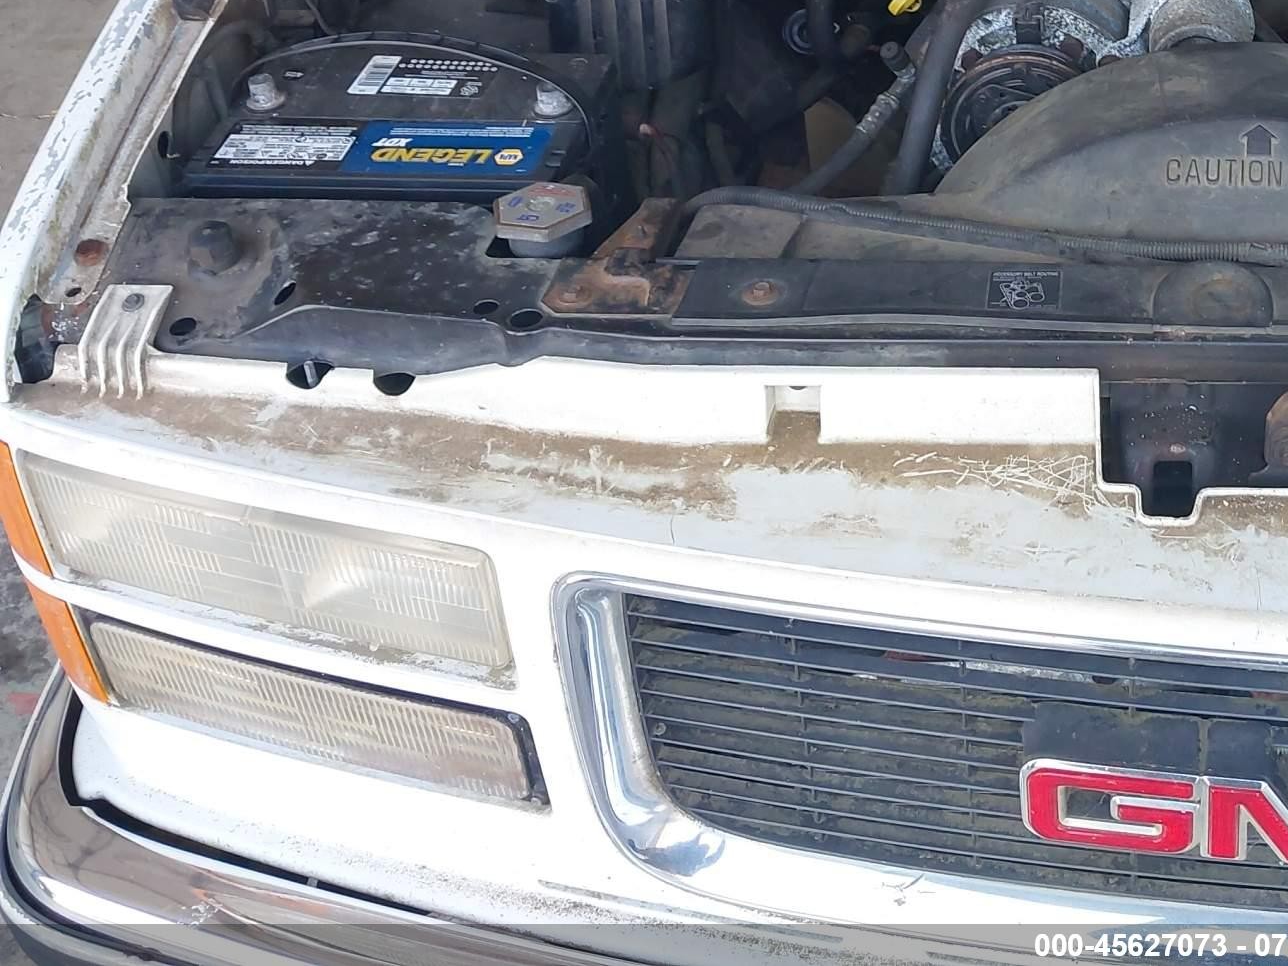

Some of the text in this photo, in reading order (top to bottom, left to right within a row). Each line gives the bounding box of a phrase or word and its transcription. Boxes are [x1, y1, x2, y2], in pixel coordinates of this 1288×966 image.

[371, 137, 413, 147] XDT
[371, 147, 492, 164] LEGEND
[1166, 158, 1283, 187] CAUTION
